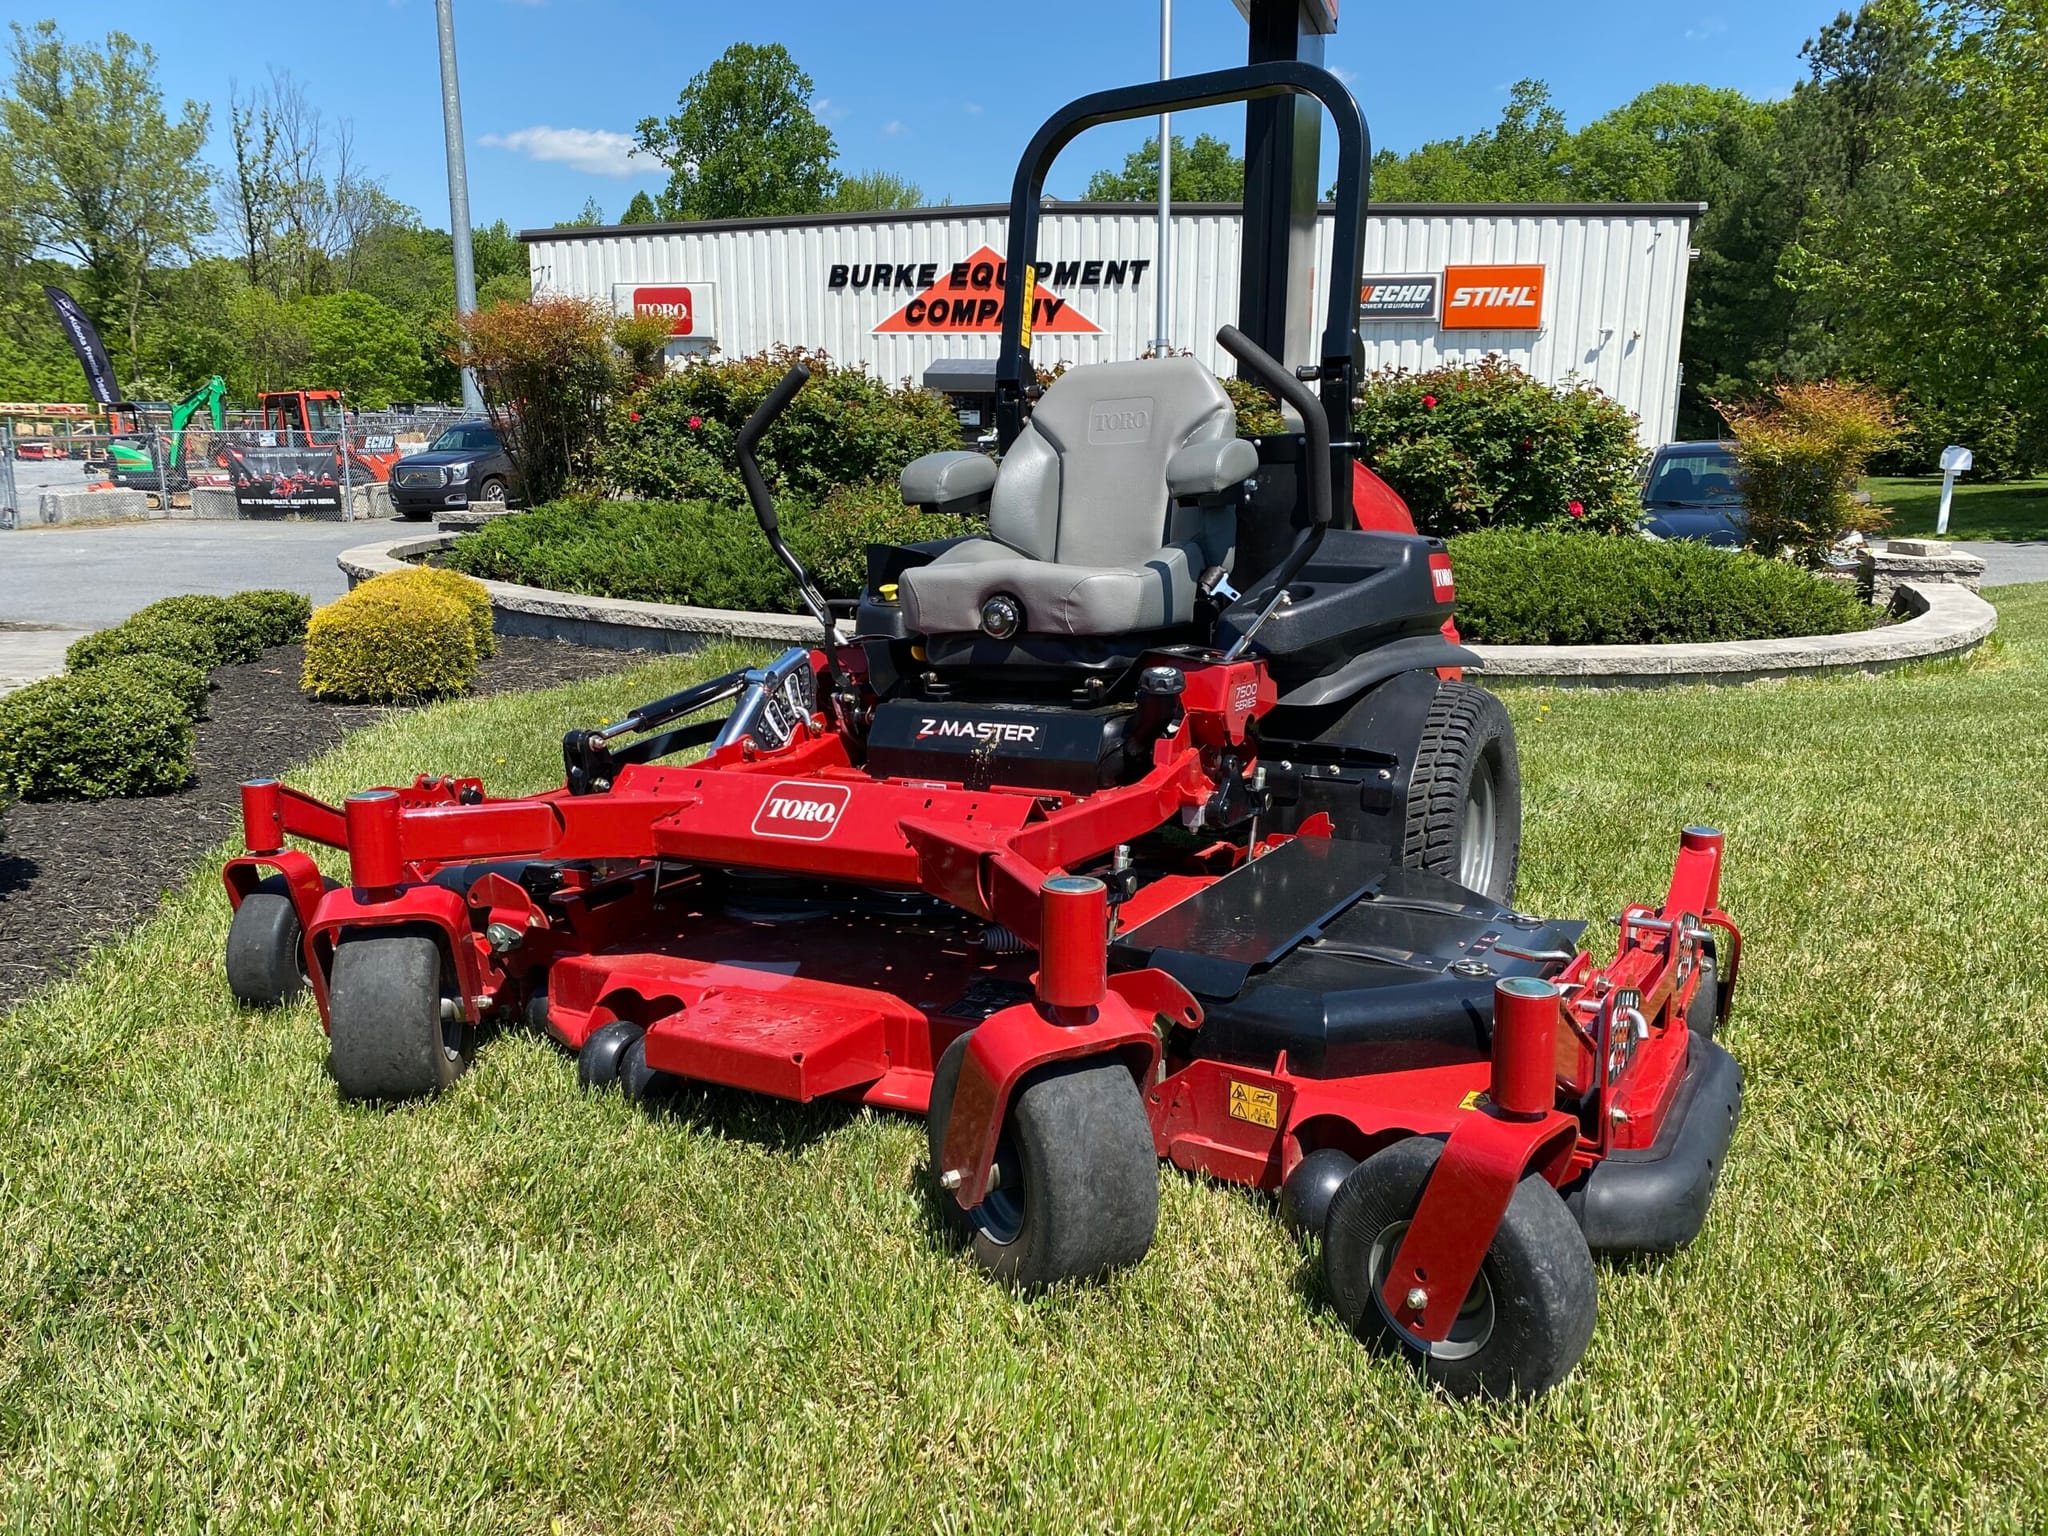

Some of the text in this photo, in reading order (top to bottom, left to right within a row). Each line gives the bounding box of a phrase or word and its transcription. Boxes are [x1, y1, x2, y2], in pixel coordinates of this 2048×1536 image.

[828, 260, 1150, 290] BURKE EQUPMENT
[1369, 285, 1432, 302] ECHO
[1450, 287, 1536, 307] STIHL
[637, 302, 687, 320] TORO
[1095, 410, 1149, 431] TORO
[365, 435, 394, 448] ECHO
[1236, 683, 1258, 699] 7500
[1235, 696, 1257, 711] SERIES
[767, 798, 835, 823] TORO
